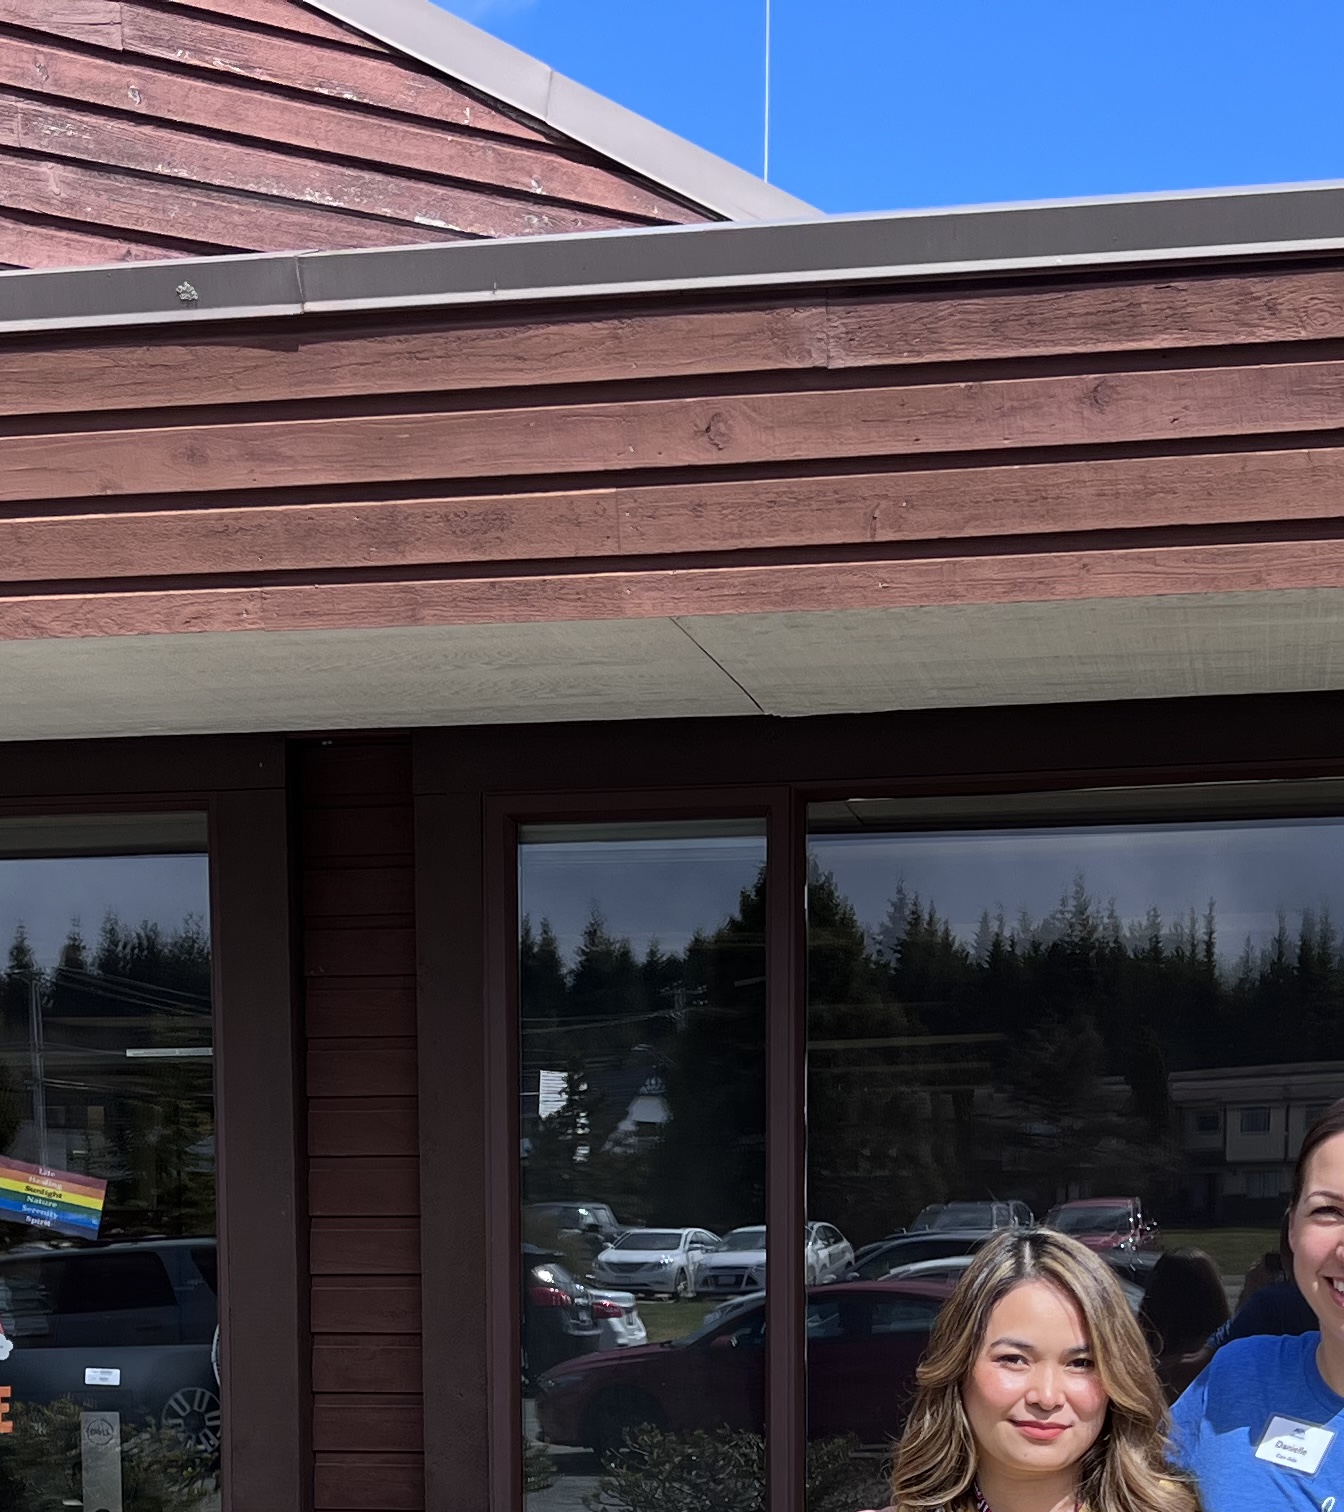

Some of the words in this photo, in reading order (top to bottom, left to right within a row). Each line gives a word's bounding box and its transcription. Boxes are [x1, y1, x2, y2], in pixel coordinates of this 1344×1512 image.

[38, 1168, 56, 1178] Life
[28, 1175, 63, 1190] Healing
[24, 1185, 63, 1199] Sunlight
[26, 1195, 58, 1208] Nature
[21, 1204, 59, 1220] Serenity
[25, 1215, 51, 1227] Spirit
